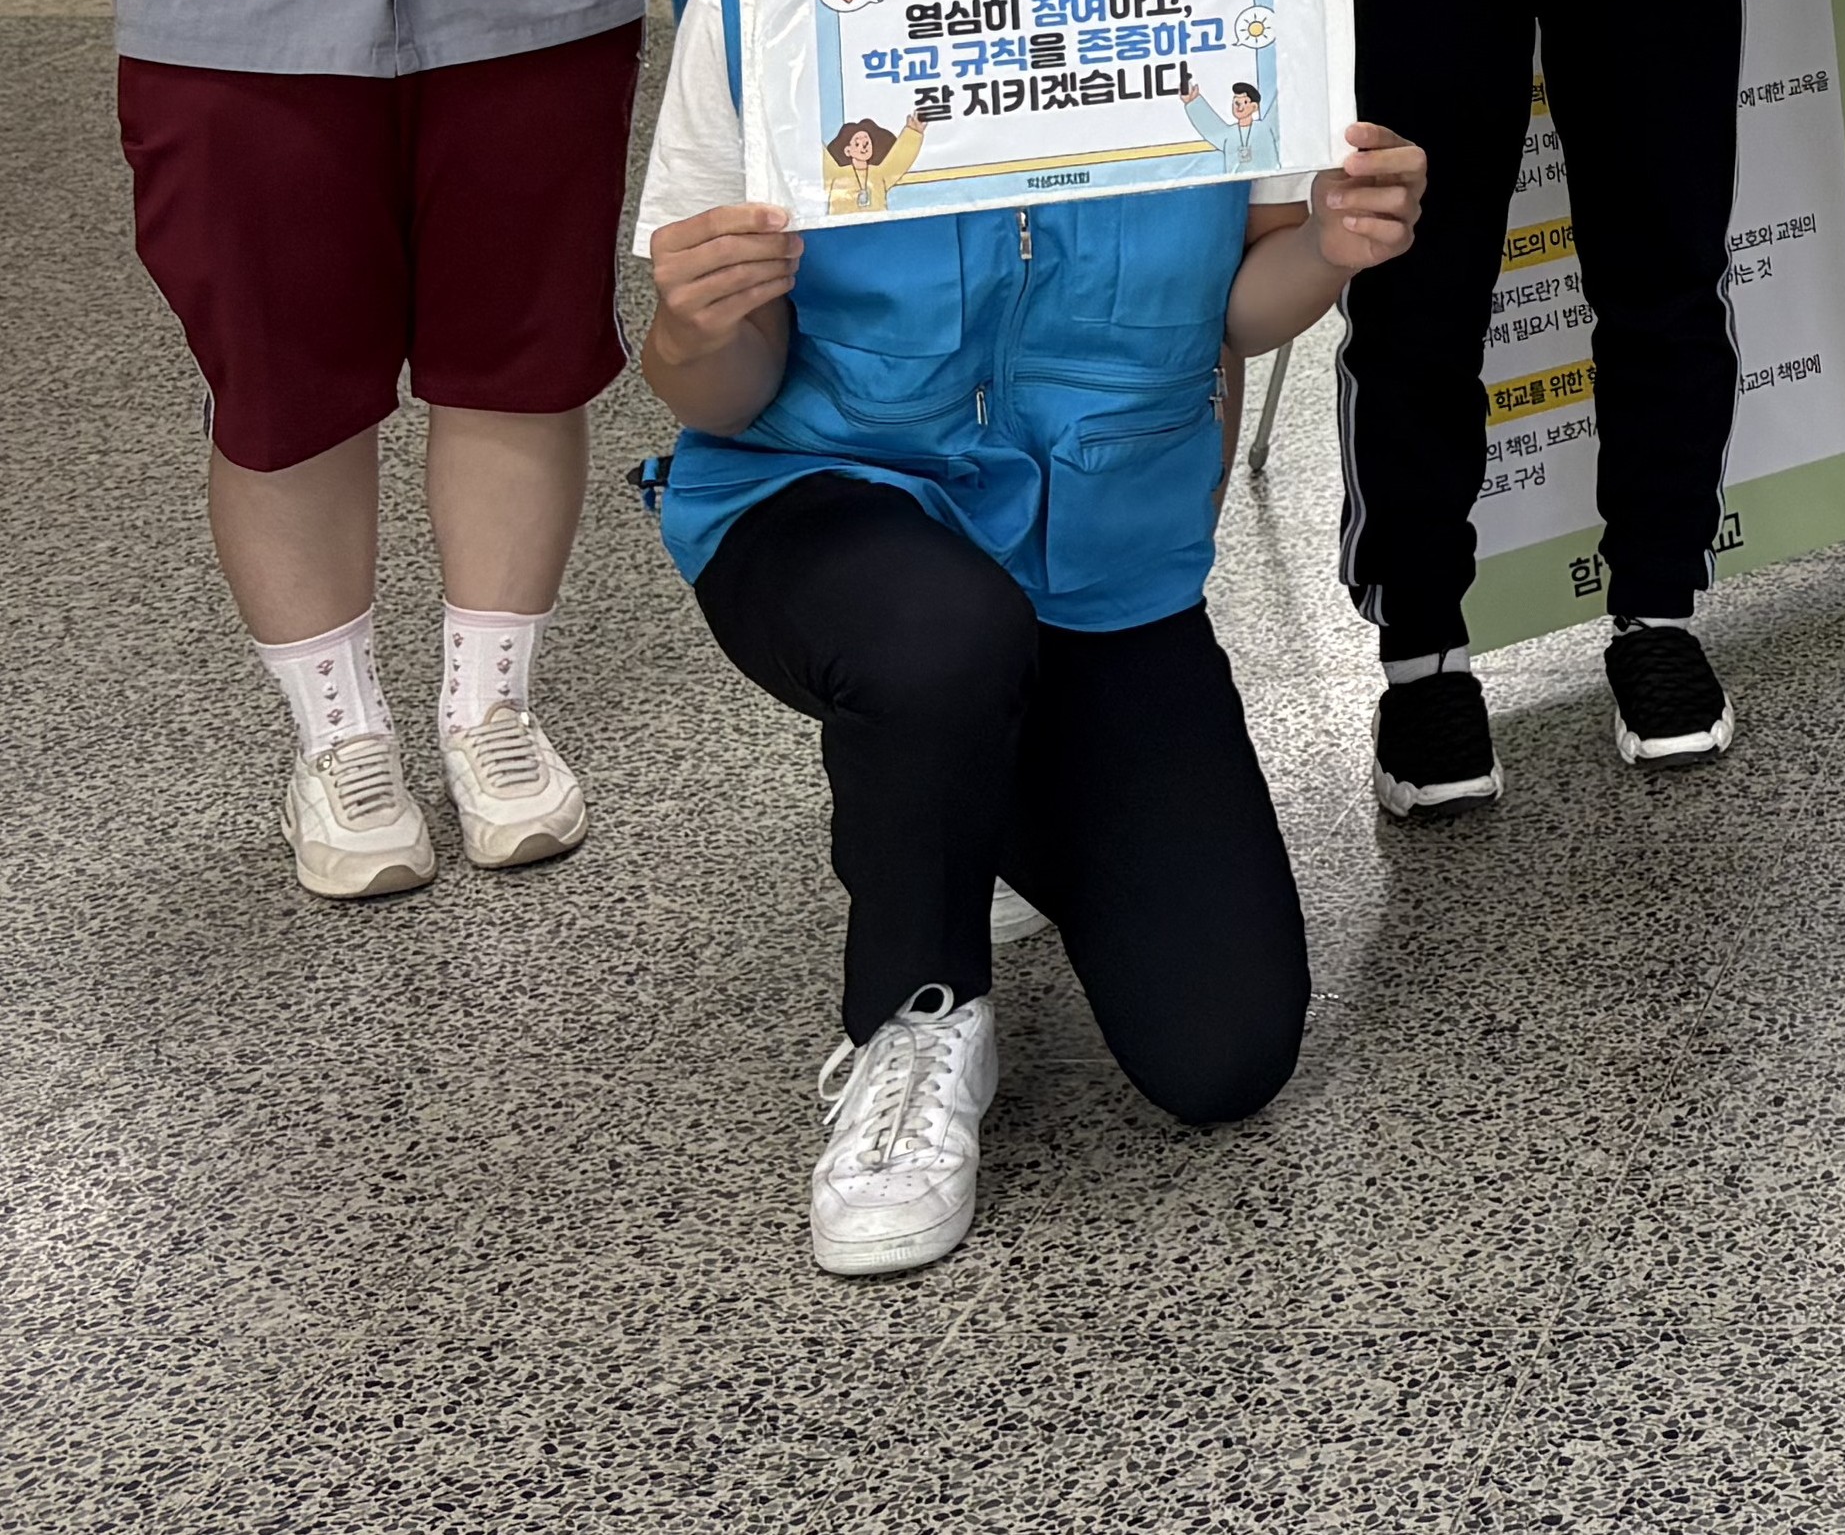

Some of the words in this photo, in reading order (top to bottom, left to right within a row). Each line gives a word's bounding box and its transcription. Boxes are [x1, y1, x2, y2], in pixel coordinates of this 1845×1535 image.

[862, 46, 940, 84] 학교
[952, 34, 1066, 77] 규칙을
[1076, 18, 1228, 66] 존중하고
[913, 84, 954, 124] 잘
[963, 61, 1193, 118] 지키겠습니다
[1788, 70, 1829, 97] 교육을
[1777, 354, 1821, 382] 책임에
[1494, 380, 1545, 412] 학교를
